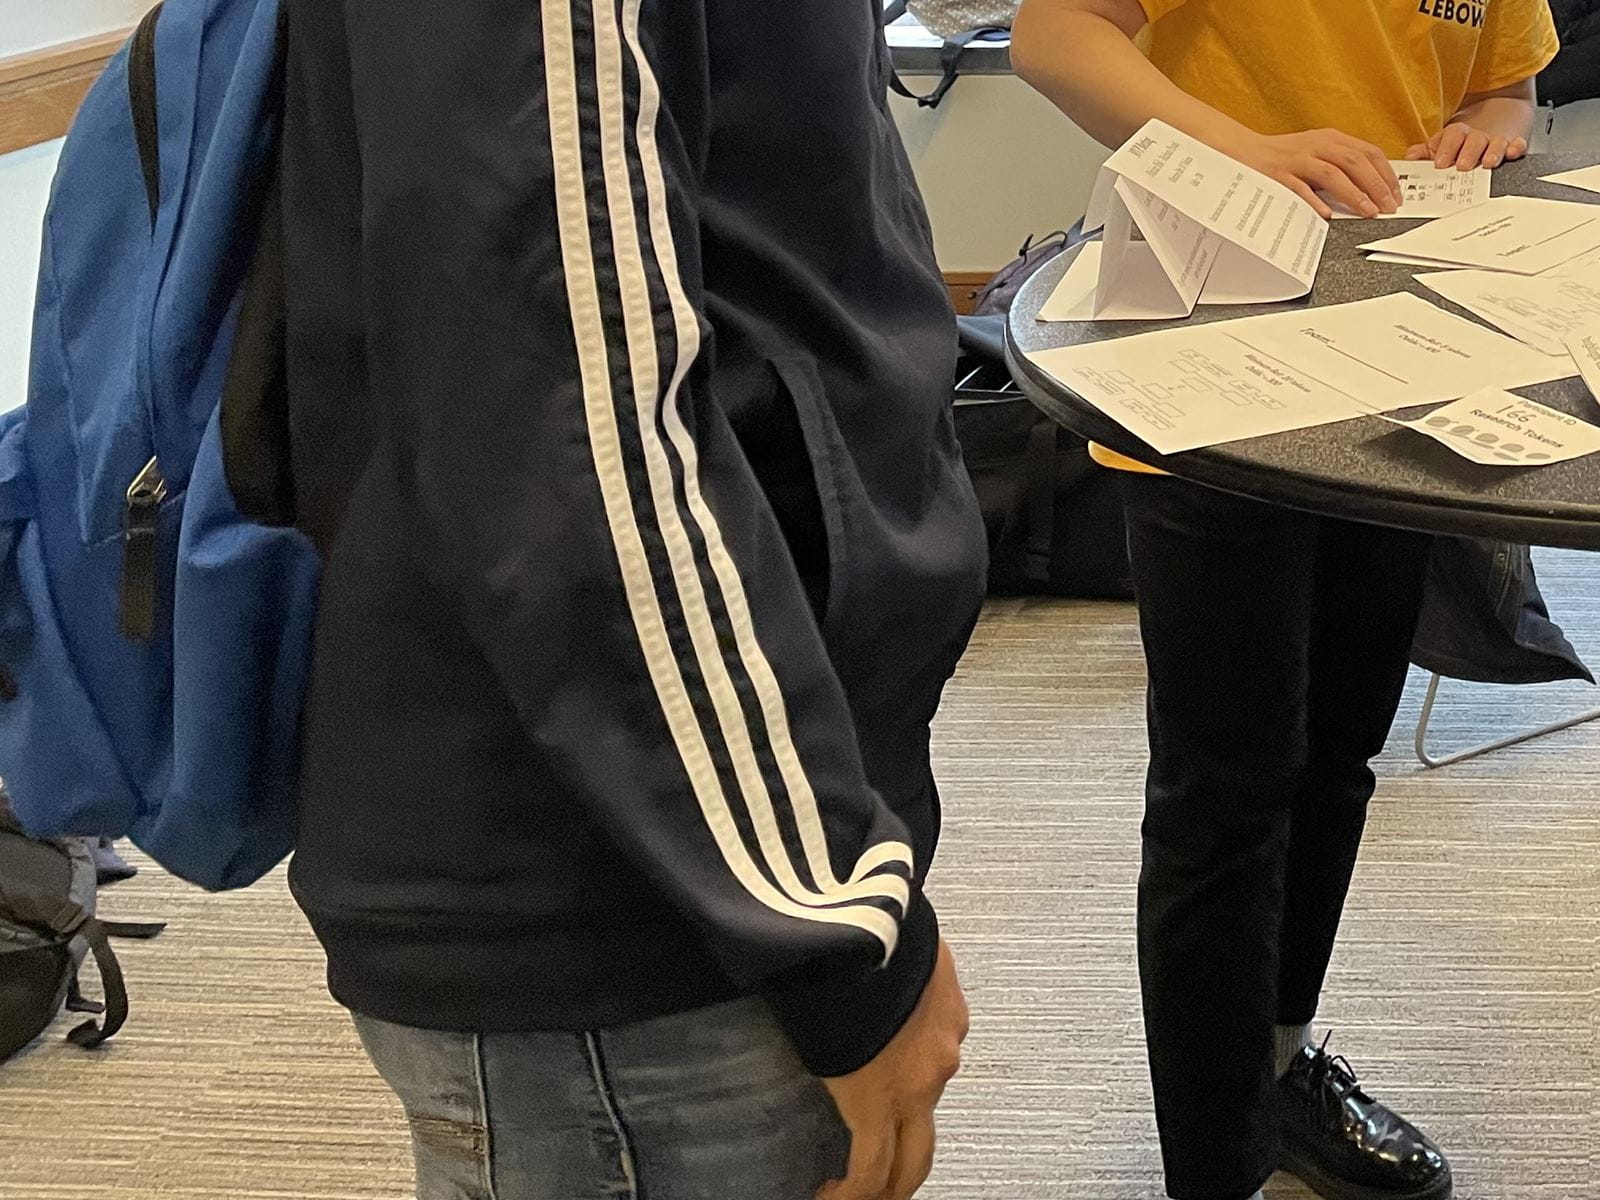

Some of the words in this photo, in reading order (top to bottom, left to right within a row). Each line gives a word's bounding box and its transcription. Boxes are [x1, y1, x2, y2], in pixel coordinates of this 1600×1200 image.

[1496, 405, 1537, 422] 166
[1563, 418, 1577, 426] ID
[1469, 409, 1521, 432] Research
[1523, 429, 1564, 448] Tokens
